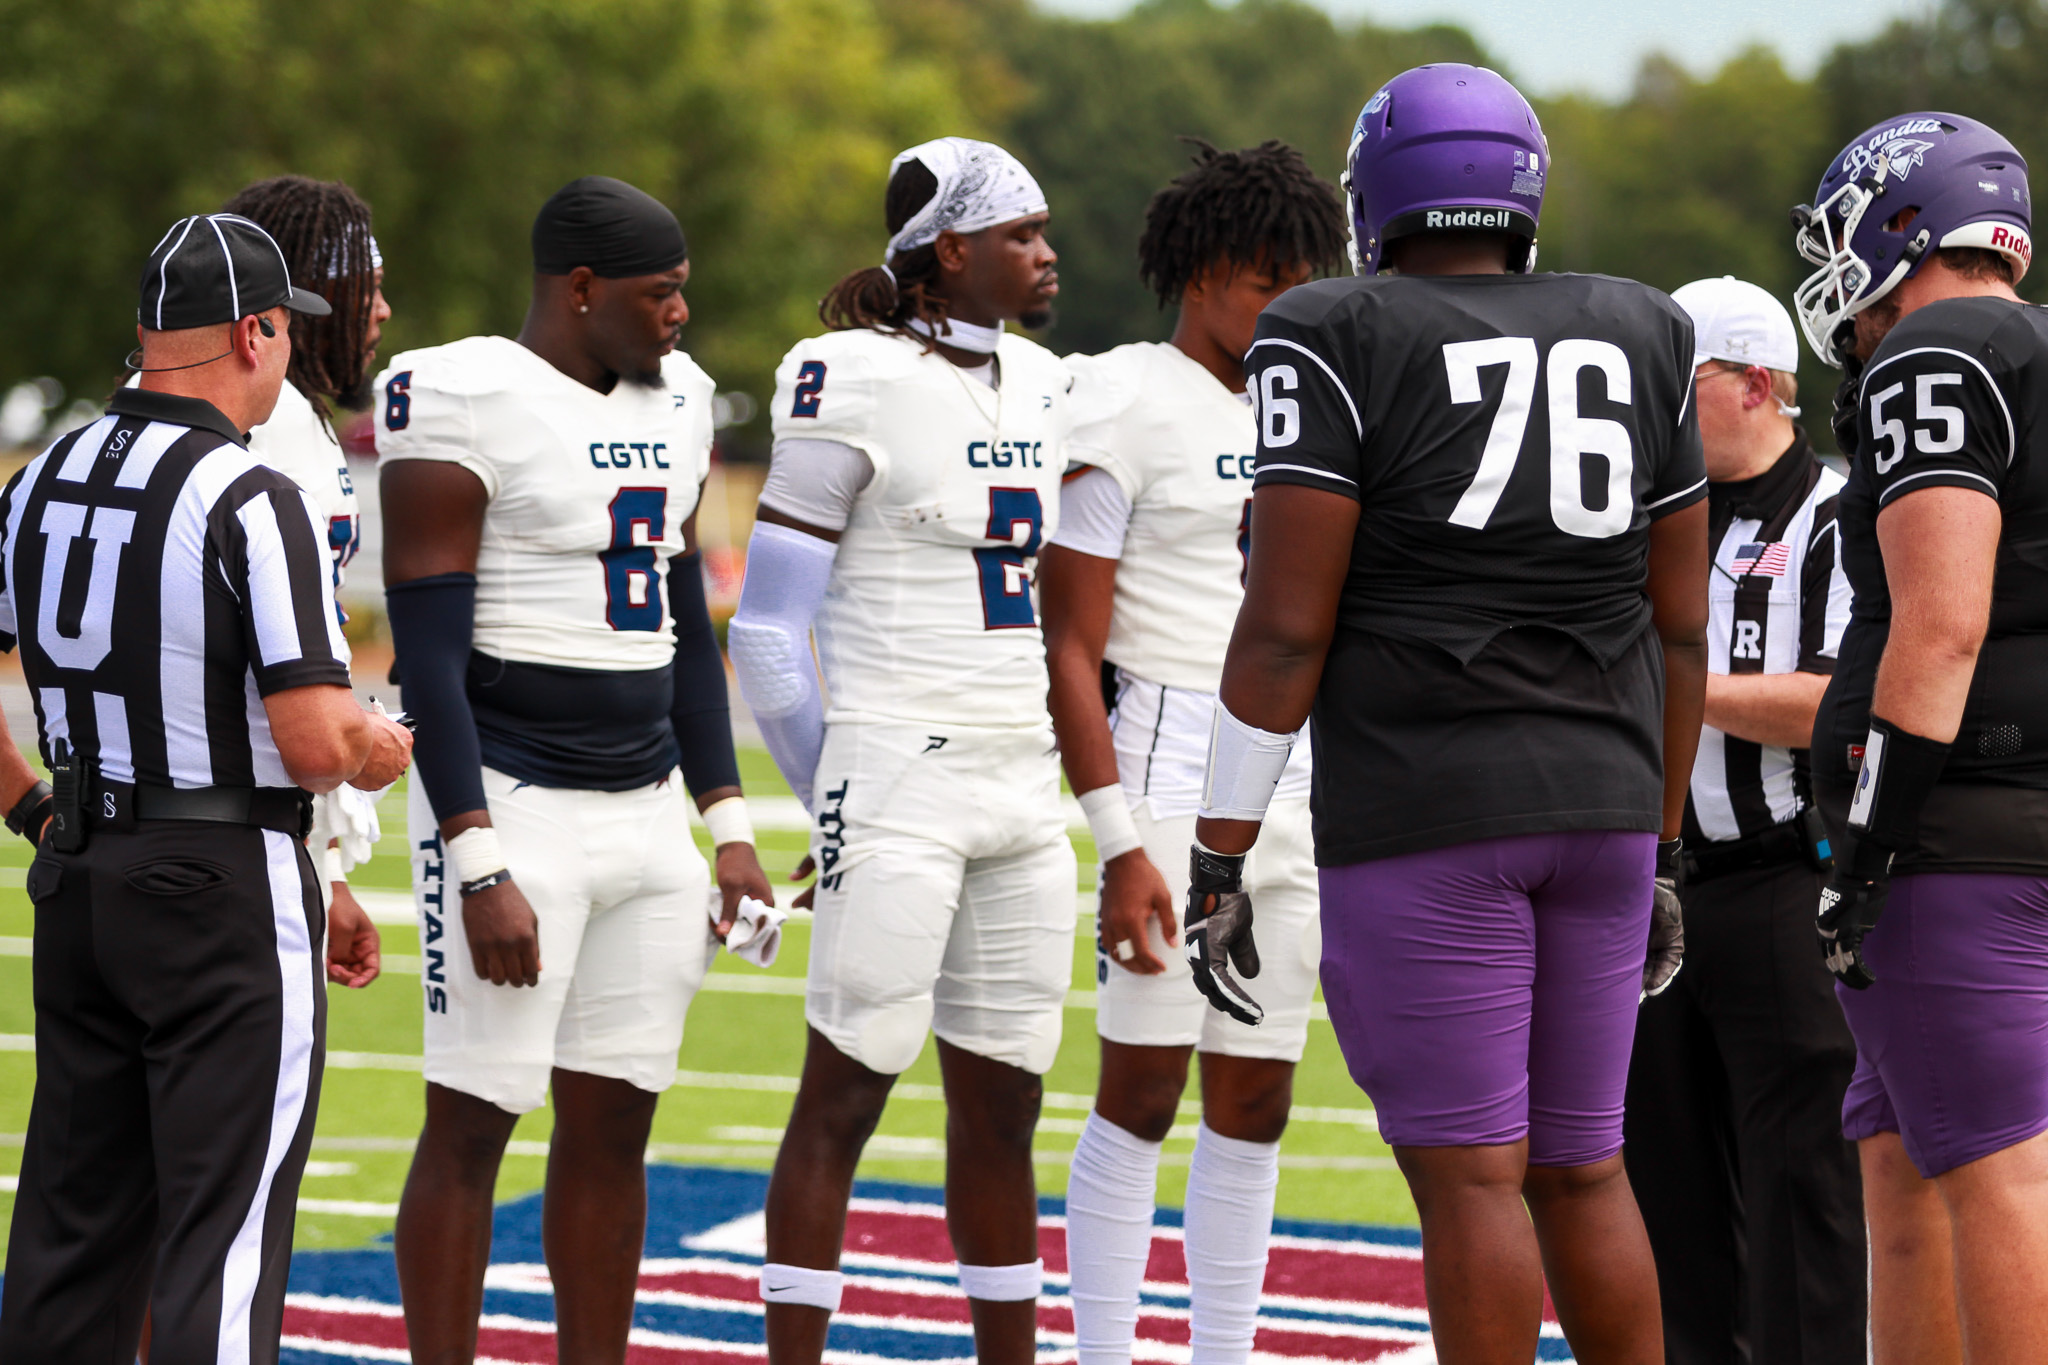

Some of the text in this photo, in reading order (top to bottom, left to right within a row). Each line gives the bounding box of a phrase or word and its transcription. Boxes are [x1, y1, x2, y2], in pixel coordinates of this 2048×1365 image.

[1843, 119, 1941, 182] Bandits
[1427, 210, 1510, 228] Riddell
[386, 371, 412, 431] 6
[791, 360, 827, 418] 2
[967, 441, 1042, 468] CGTC
[1442, 336, 1633, 538] 76
[1870, 373, 1965, 475] 55
[589, 443, 670, 468] CGTC
[1217, 454, 1256, 479] CG
[37, 500, 137, 671] U
[597, 486, 668, 632] 6
[971, 486, 1043, 630] 2
[1733, 620, 1761, 659] R
[419, 829, 447, 1015] TITANS
